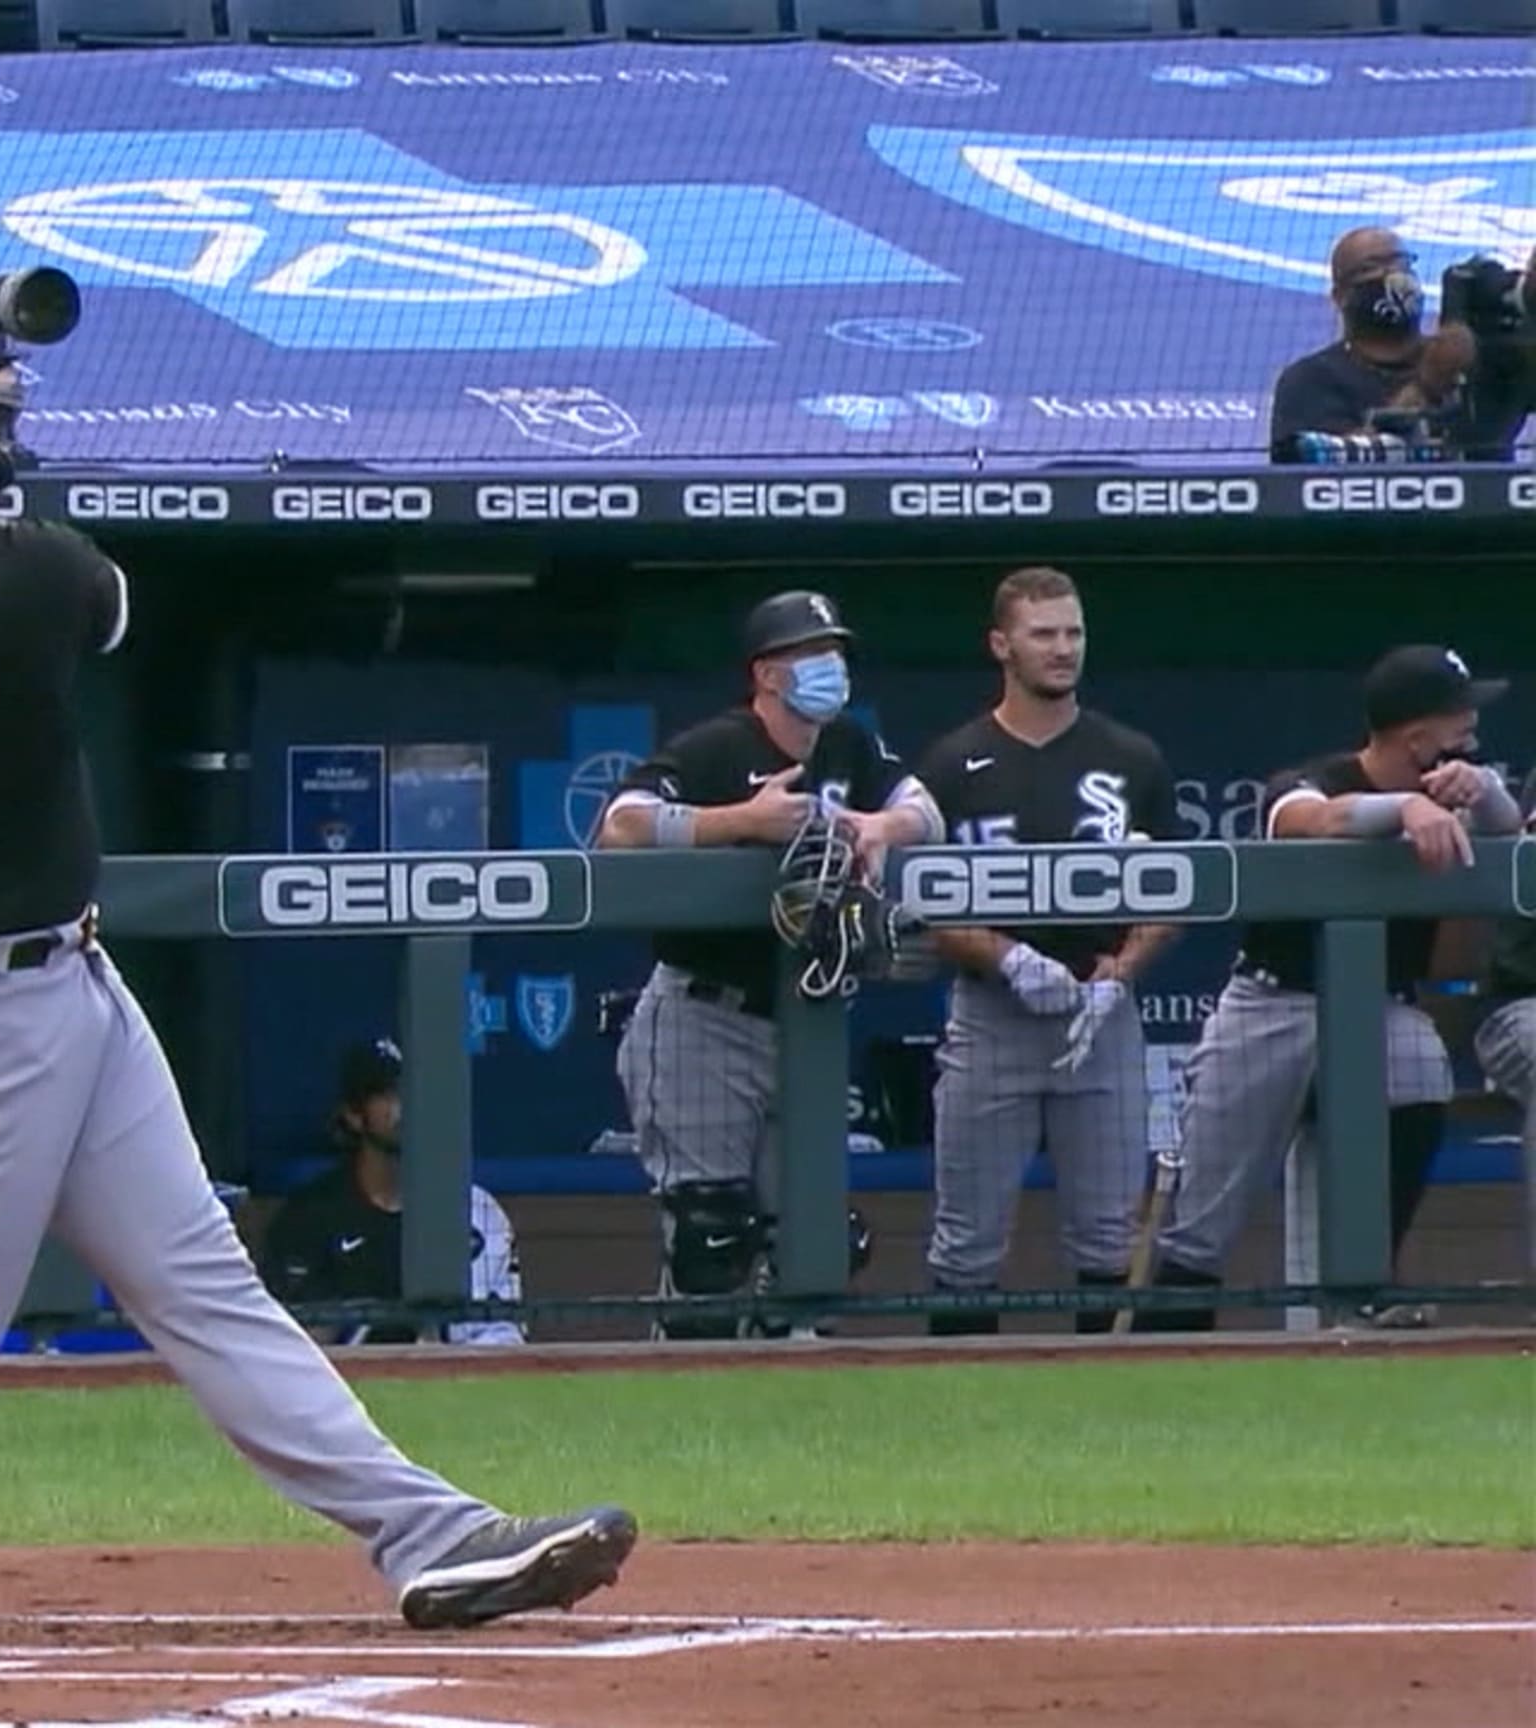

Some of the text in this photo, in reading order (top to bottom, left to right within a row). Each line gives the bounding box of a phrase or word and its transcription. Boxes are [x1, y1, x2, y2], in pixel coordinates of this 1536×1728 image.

[1362, 65, 1536, 81] Kansa
[21, 401, 351, 424] ansas City
[1030, 396, 1257, 420] Kansas
[68, 486, 229, 519] GEICO
[273, 487, 432, 519] GEICO
[477, 486, 639, 518] GEICO
[684, 484, 846, 517] GEICO
[891, 483, 1052, 516] GEICO
[1097, 480, 1259, 514] GEICO
[1303, 477, 1464, 510] GEICO
[260, 860, 550, 926] GEICO
[901, 852, 1195, 915] GEICO
